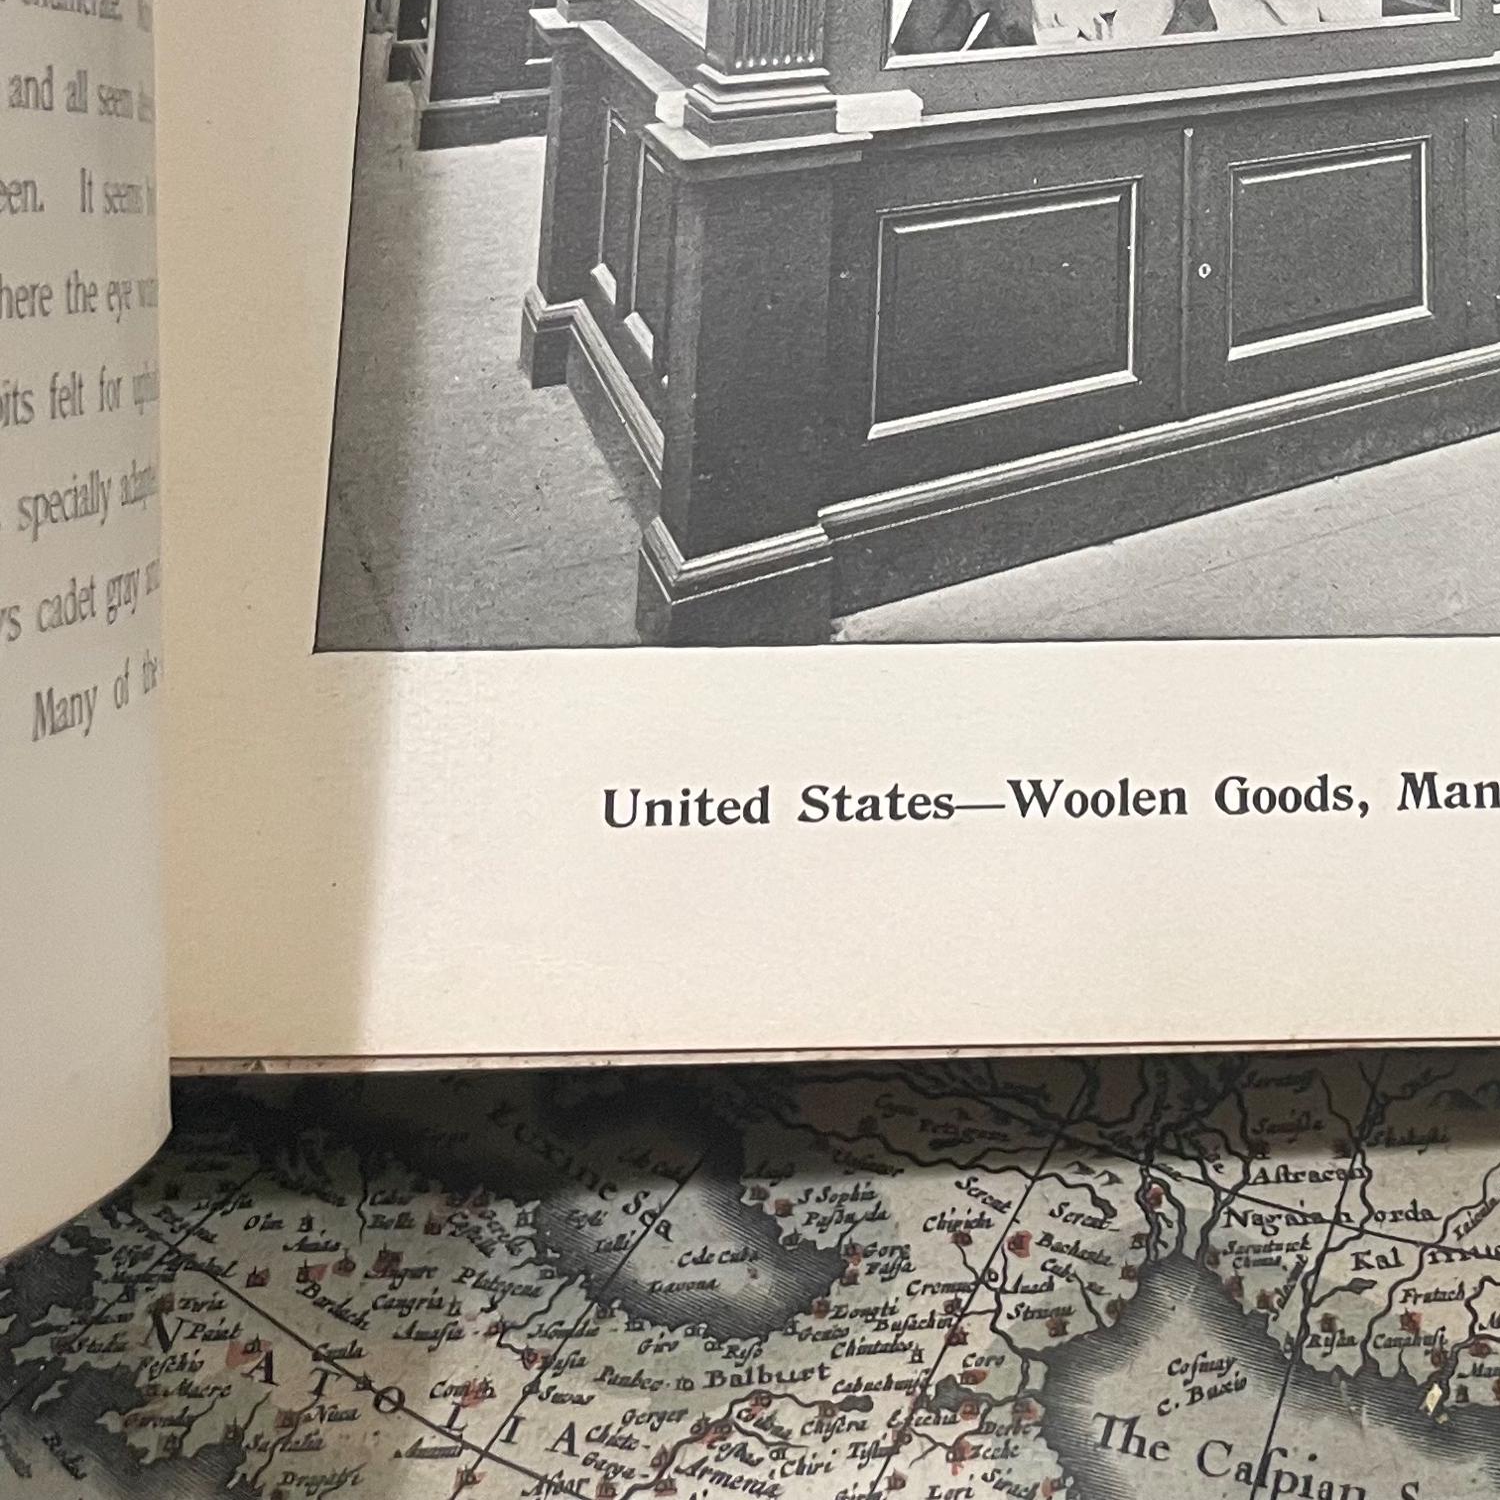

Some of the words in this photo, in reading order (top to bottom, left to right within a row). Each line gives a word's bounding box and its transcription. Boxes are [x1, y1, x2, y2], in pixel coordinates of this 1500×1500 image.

[8, 64, 54, 112] and
[65, 267, 99, 317] the
[49, 370, 86, 421] felt
[17, 466, 113, 543] specially
[36, 574, 98, 634] cadet
[31, 683, 99, 744] Many
[604, 785, 770, 828] United
[1214, 773, 1369, 819] Goods,
[1092, 1411, 1173, 1463] The
